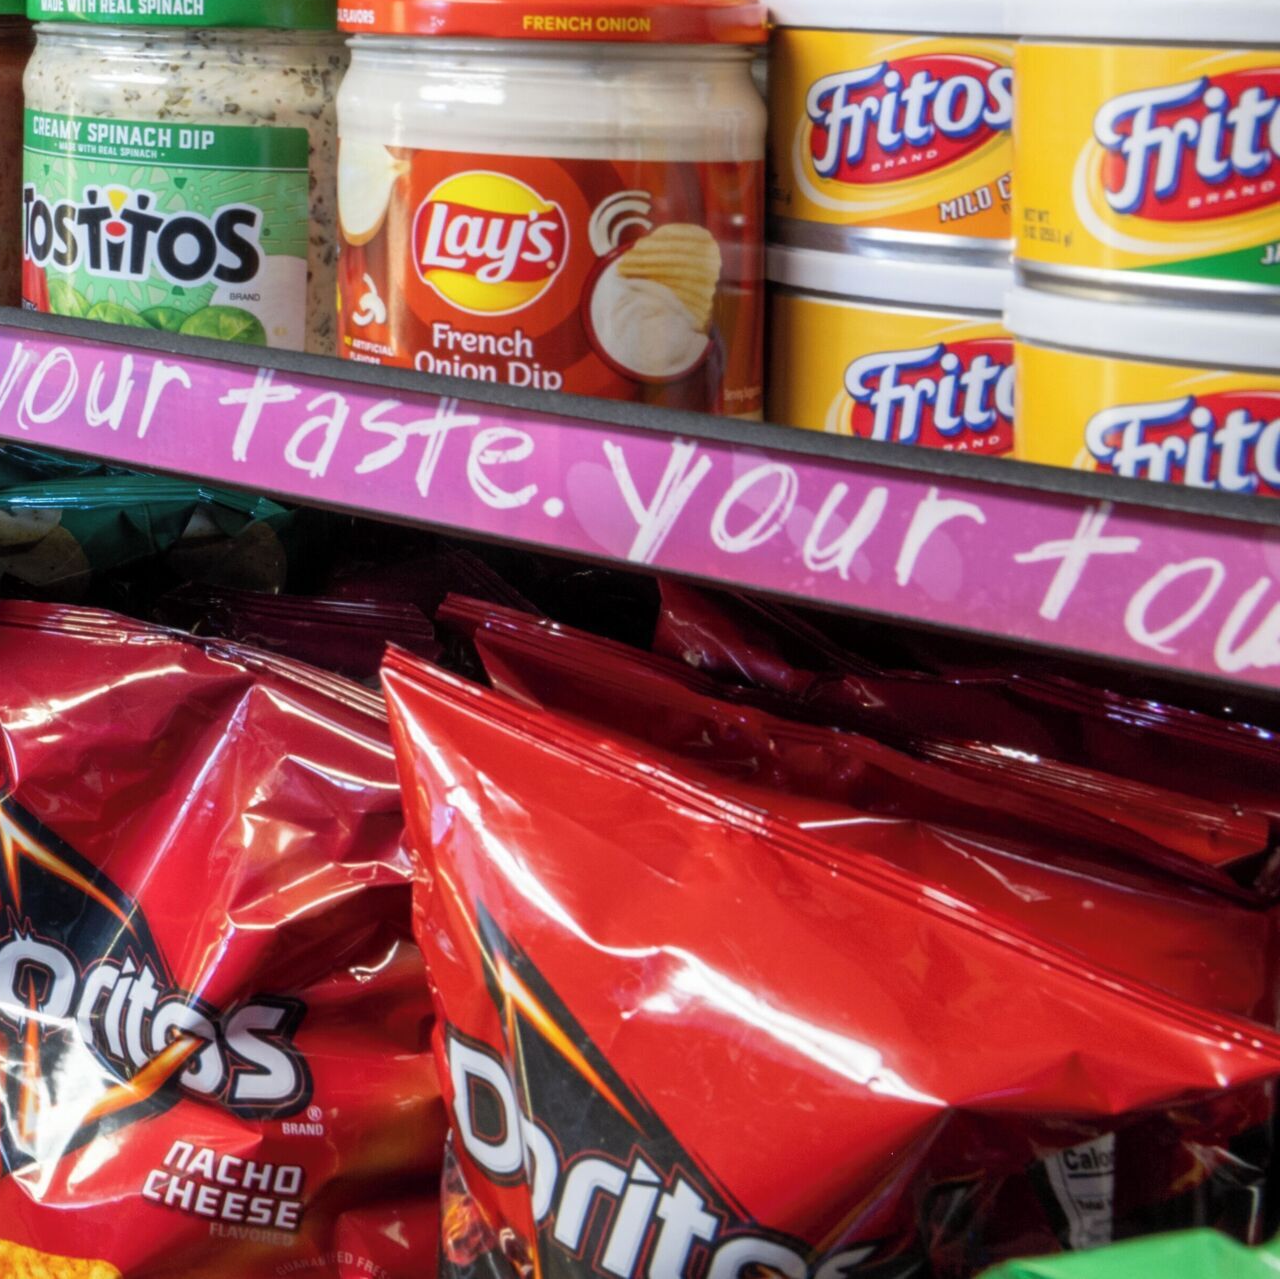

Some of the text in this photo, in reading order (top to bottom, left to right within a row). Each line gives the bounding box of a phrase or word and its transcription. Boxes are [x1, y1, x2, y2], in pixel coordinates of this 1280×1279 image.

[522, 15, 652, 33] FRENCH ONION
[33, 115, 216, 148] CREAMY SPINACH DIP
[806, 61, 1015, 179] Fritos
[871, 149, 938, 173] BRAND
[940, 190, 992, 223] MILD
[1188, 179, 1277, 209] BRAND
[421, 201, 559, 285] Lay's
[228, 292, 261, 301] BRAND
[432, 323, 534, 359] French
[414, 351, 563, 391] Onion Dip
[218, 367, 564, 518] taste.
[602, 436, 987, 587] your
[282, 1121, 324, 1137] BRAND
[141, 1169, 305, 1231] CHEESE
[208, 1222, 296, 1247] FLAVORED
